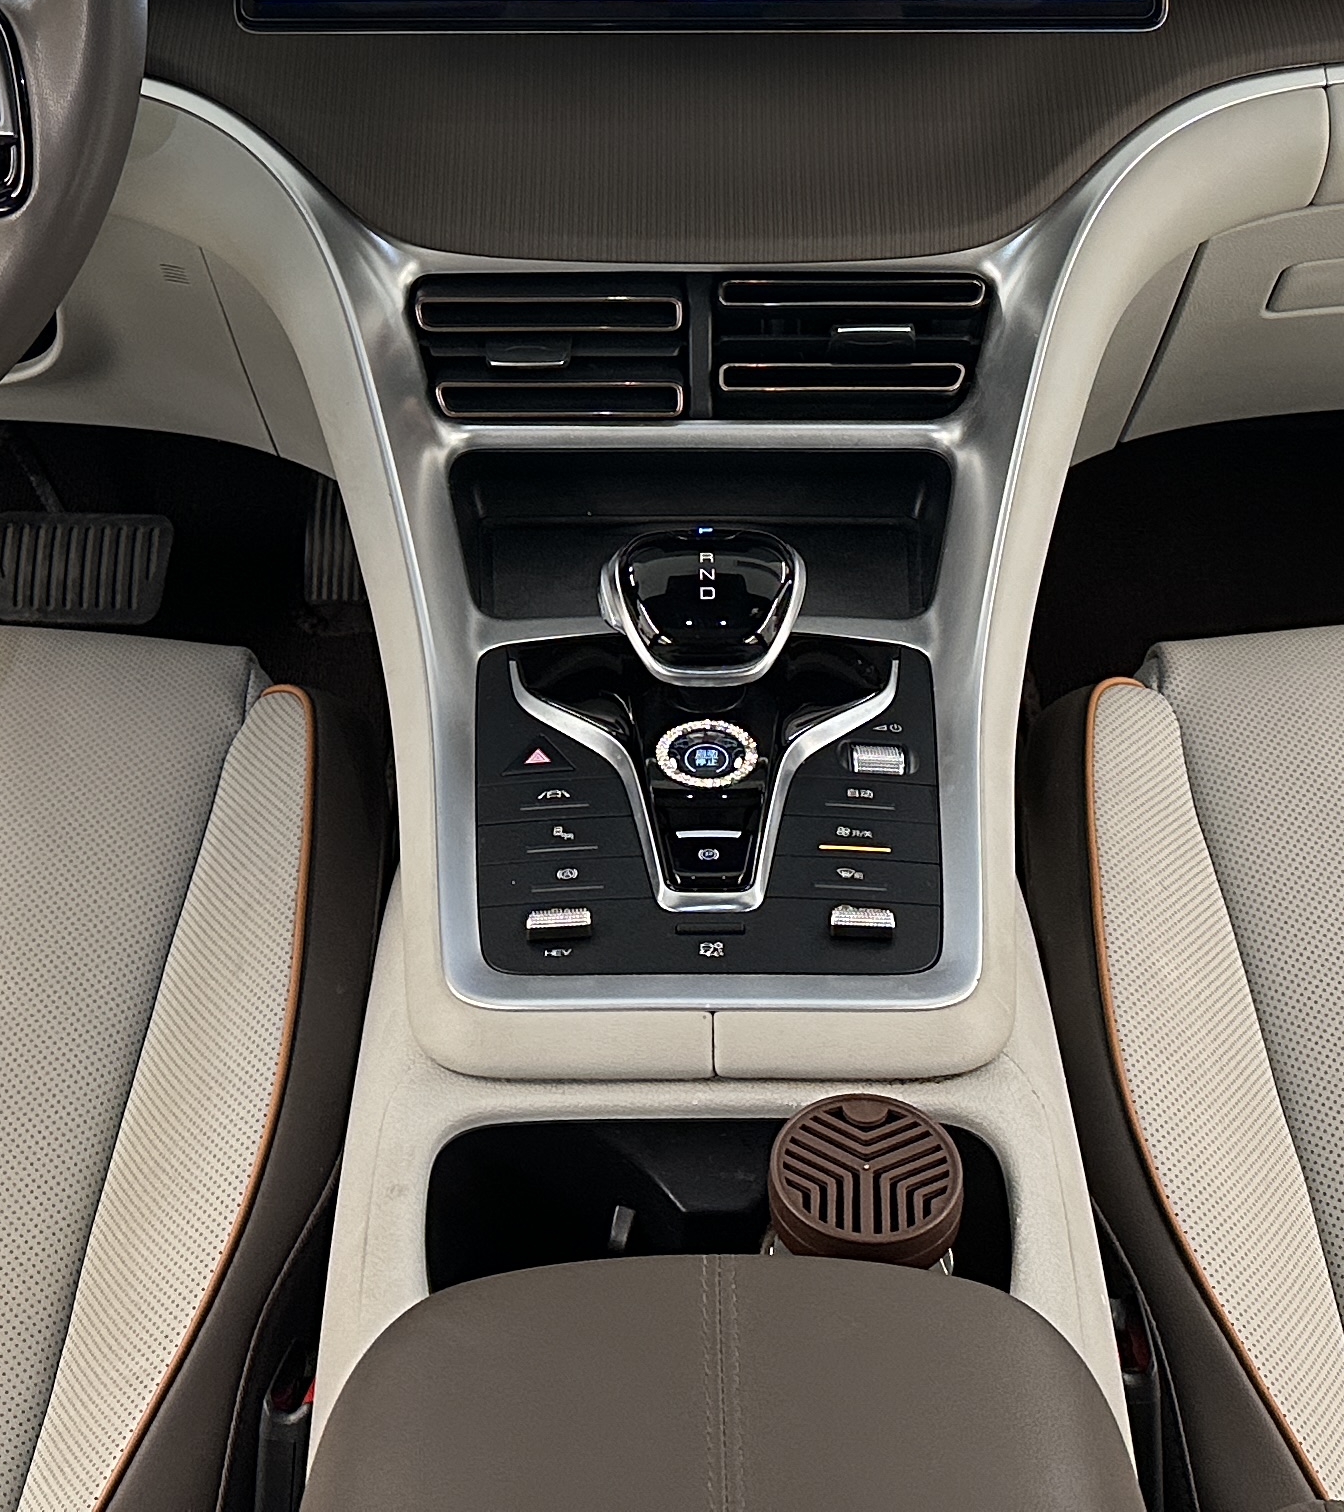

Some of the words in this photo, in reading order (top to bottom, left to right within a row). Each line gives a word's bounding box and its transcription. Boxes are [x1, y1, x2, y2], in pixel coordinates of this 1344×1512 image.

[699, 552, 714, 564] R
[699, 568, 715, 581] N
[699, 586, 716, 601] D
[544, 949, 572, 957] HEV
